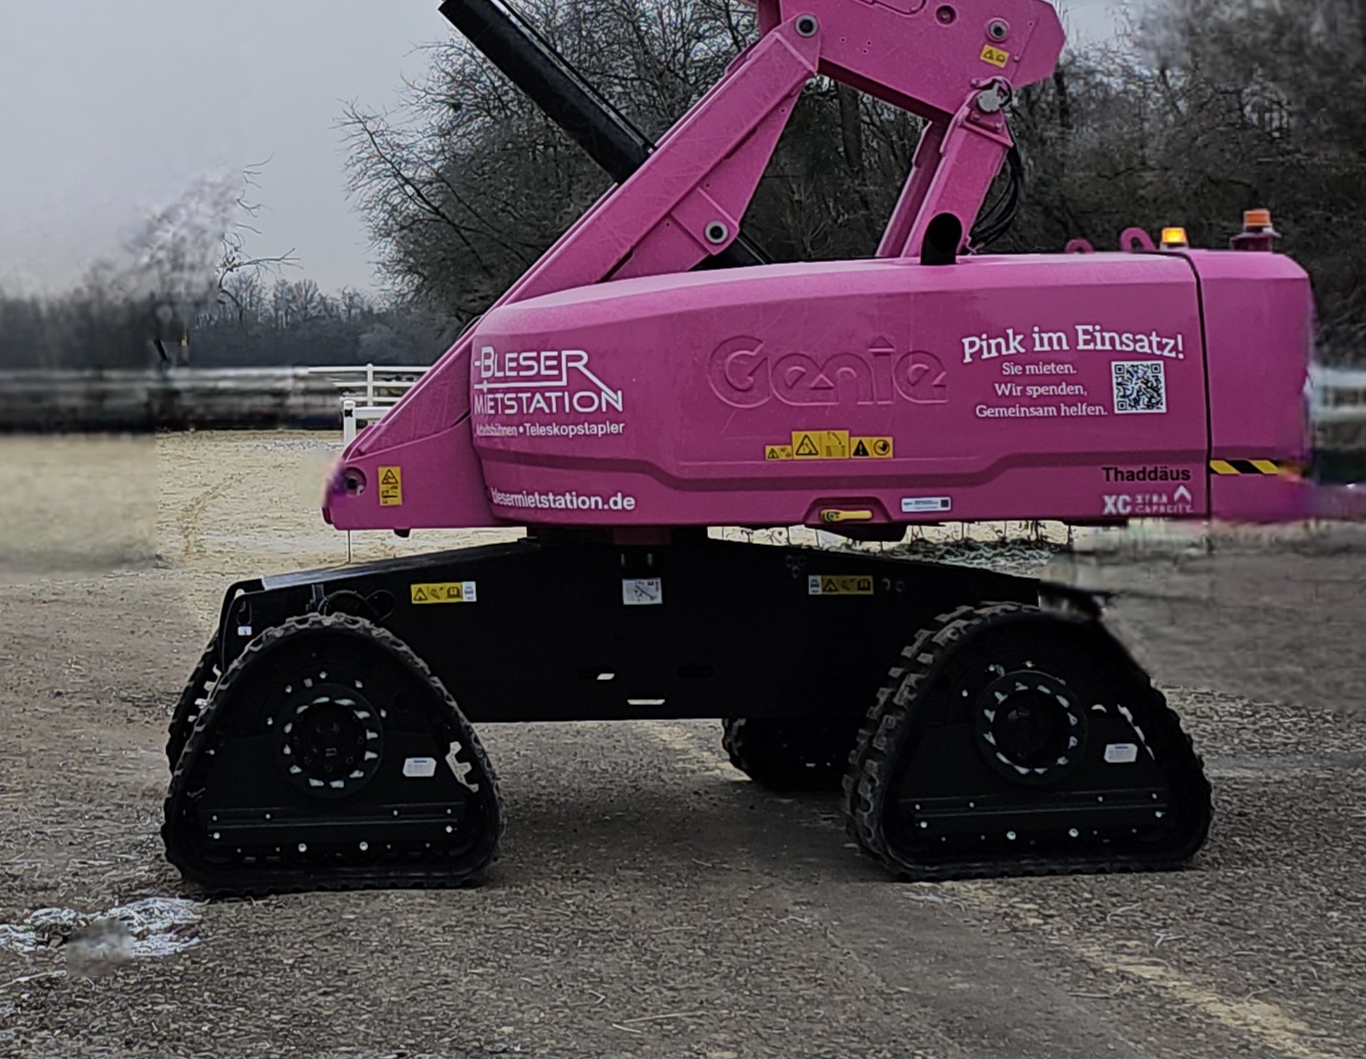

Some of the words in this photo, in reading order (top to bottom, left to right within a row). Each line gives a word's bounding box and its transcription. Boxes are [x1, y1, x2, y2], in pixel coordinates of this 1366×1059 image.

[962, 329, 1026, 363] Pink
[1032, 326, 1069, 351] im
[1075, 325, 1185, 359] Einsatz!
[707, 335, 949, 408] Genie
[1002, 362, 1023, 375] Sie
[1025, 362, 1077, 374] mieten.
[994, 382, 1023, 396] Wir
[474, 390, 623, 415] MIETSTATION
[975, 403, 1057, 417] Gemeinsam
[1060, 402, 1108, 416] helfen.
[524, 421, 625, 438] Teleskopstapler
[1101, 466, 1191, 482] Thaddäus
[490, 487, 635, 510] blesermietstation.de
[1102, 494, 1132, 516] XC
